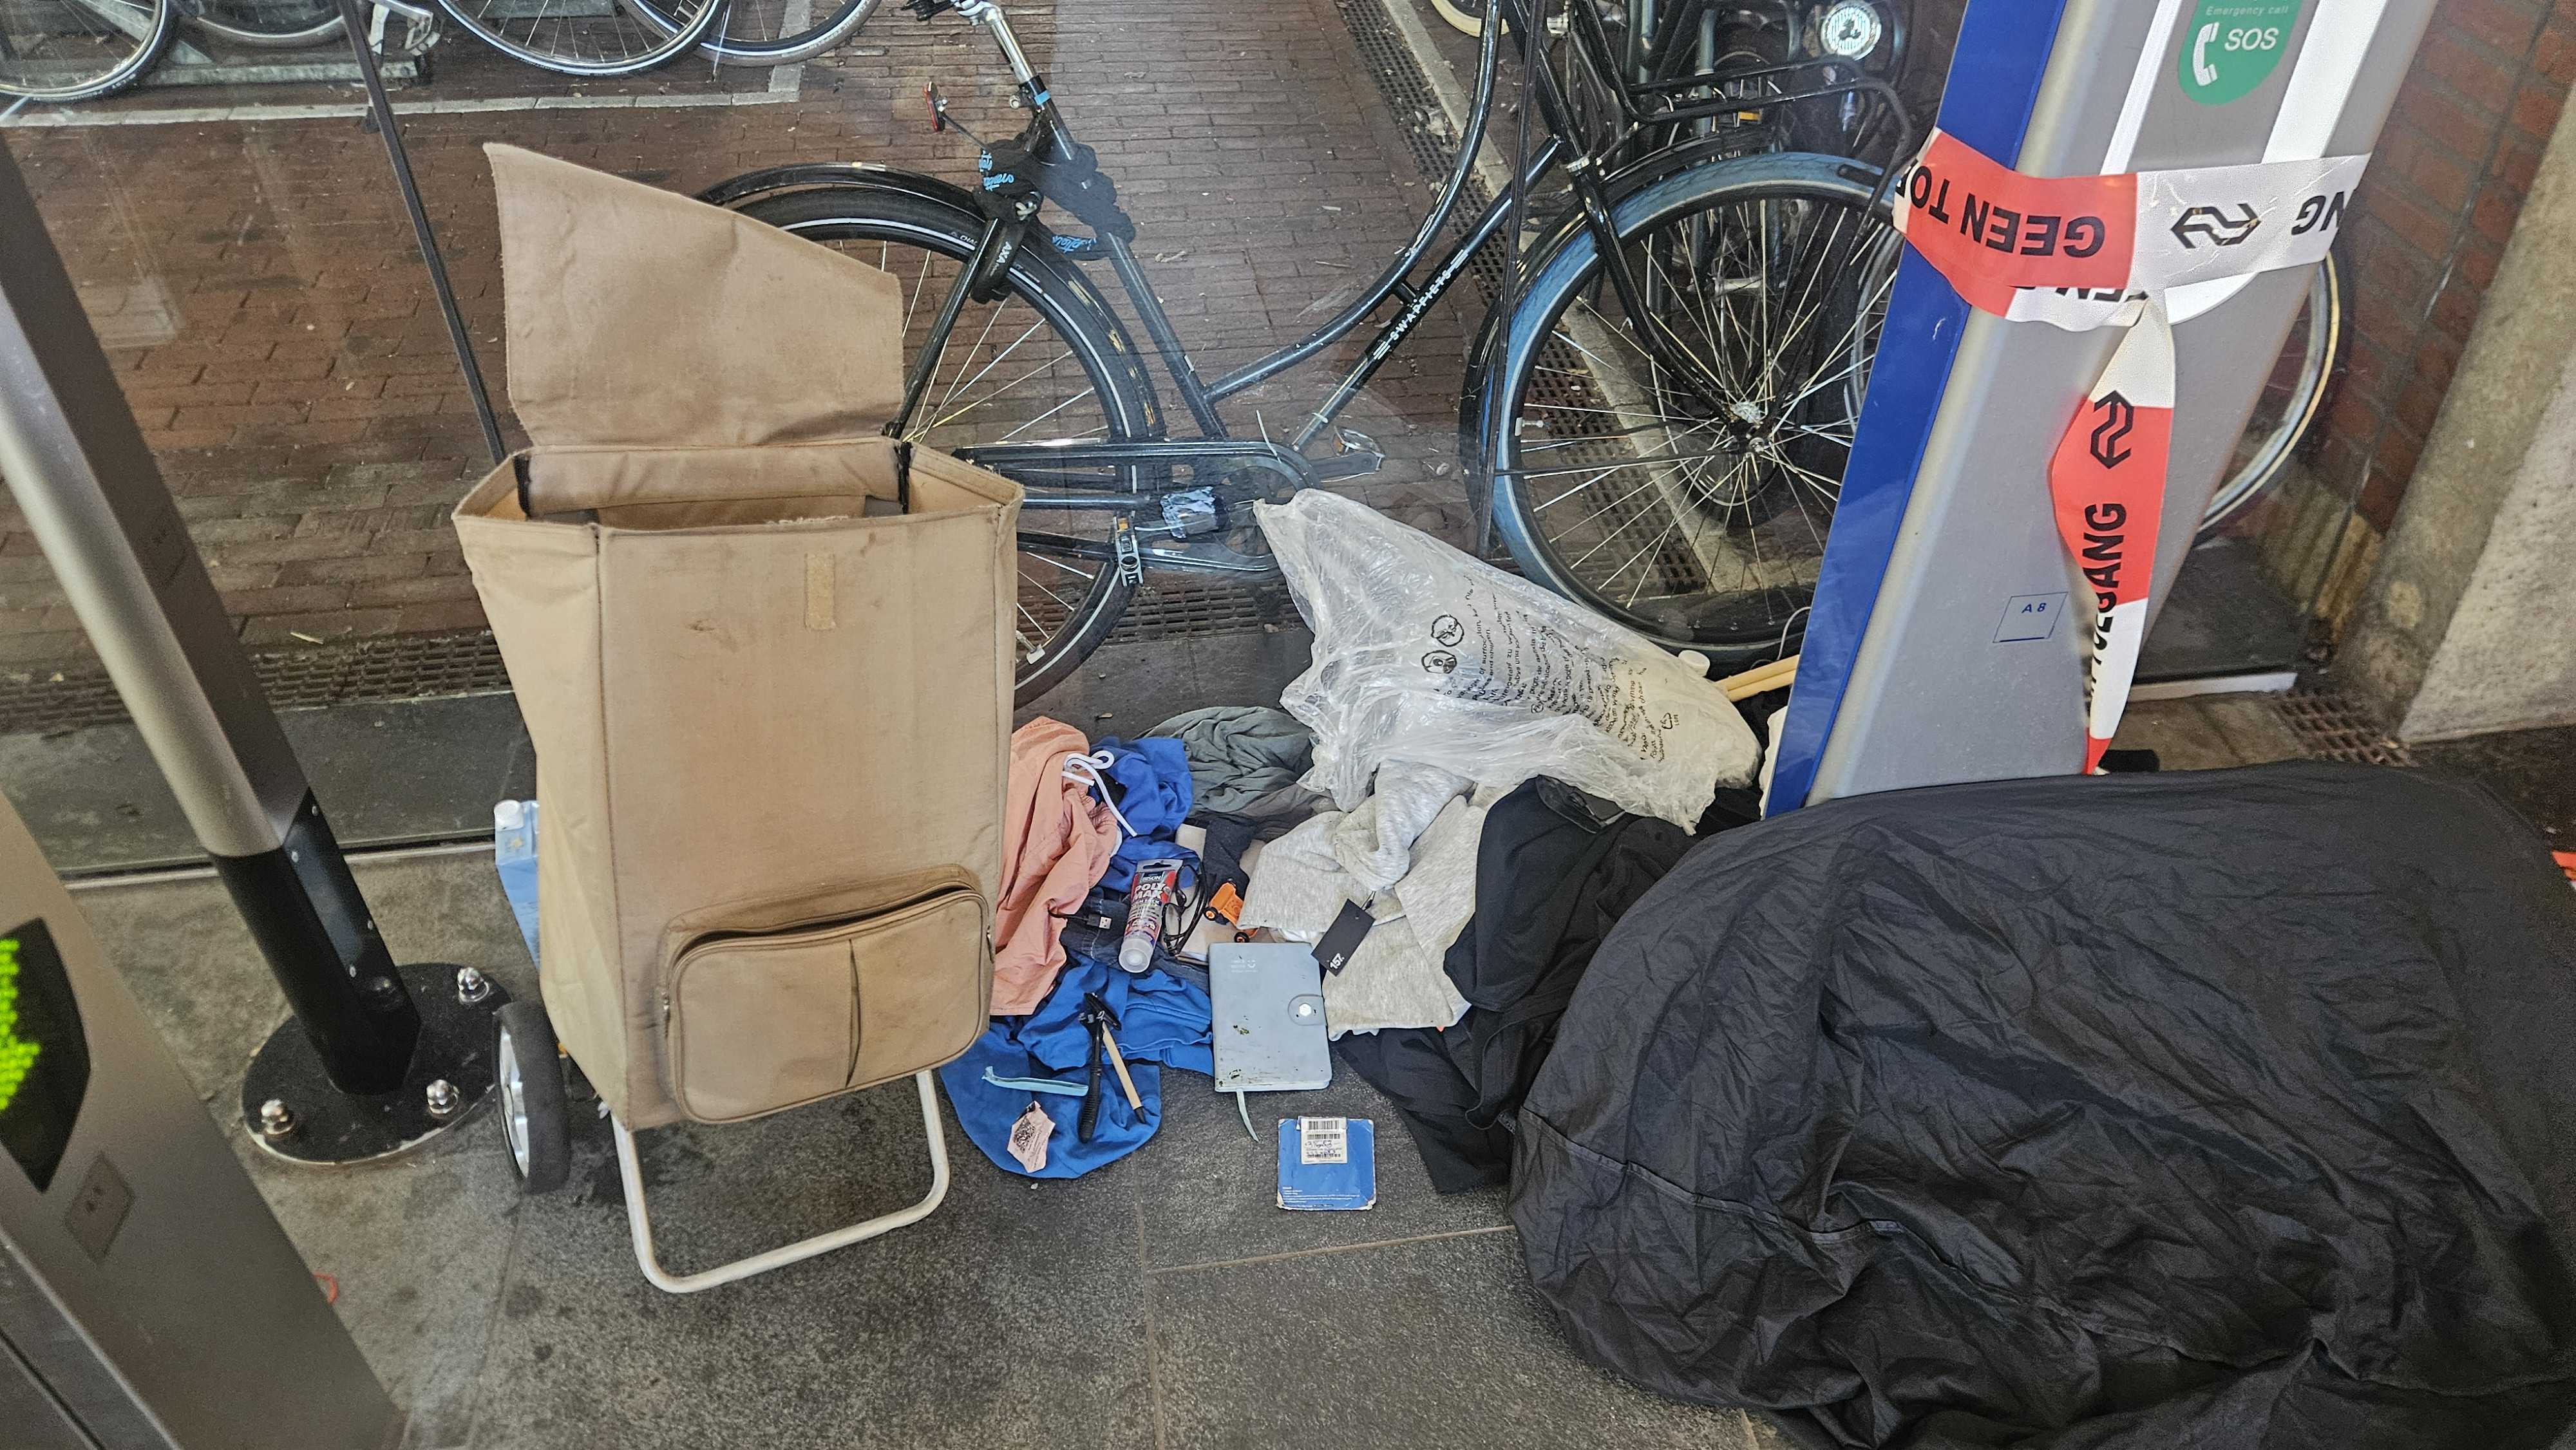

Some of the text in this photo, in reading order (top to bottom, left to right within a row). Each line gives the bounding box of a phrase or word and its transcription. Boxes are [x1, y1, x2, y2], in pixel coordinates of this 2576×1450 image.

[2206, 6, 2289, 16] Emergency call
[2224, 28, 2279, 51] SOS
[1960, 193, 2105, 258] GEEN
[996, 241, 1012, 263] AXA
[1390, 270, 1452, 341] SWAPFIETS
[2022, 603, 2047, 613] A 8
[1134, 883, 1166, 894] POLY
